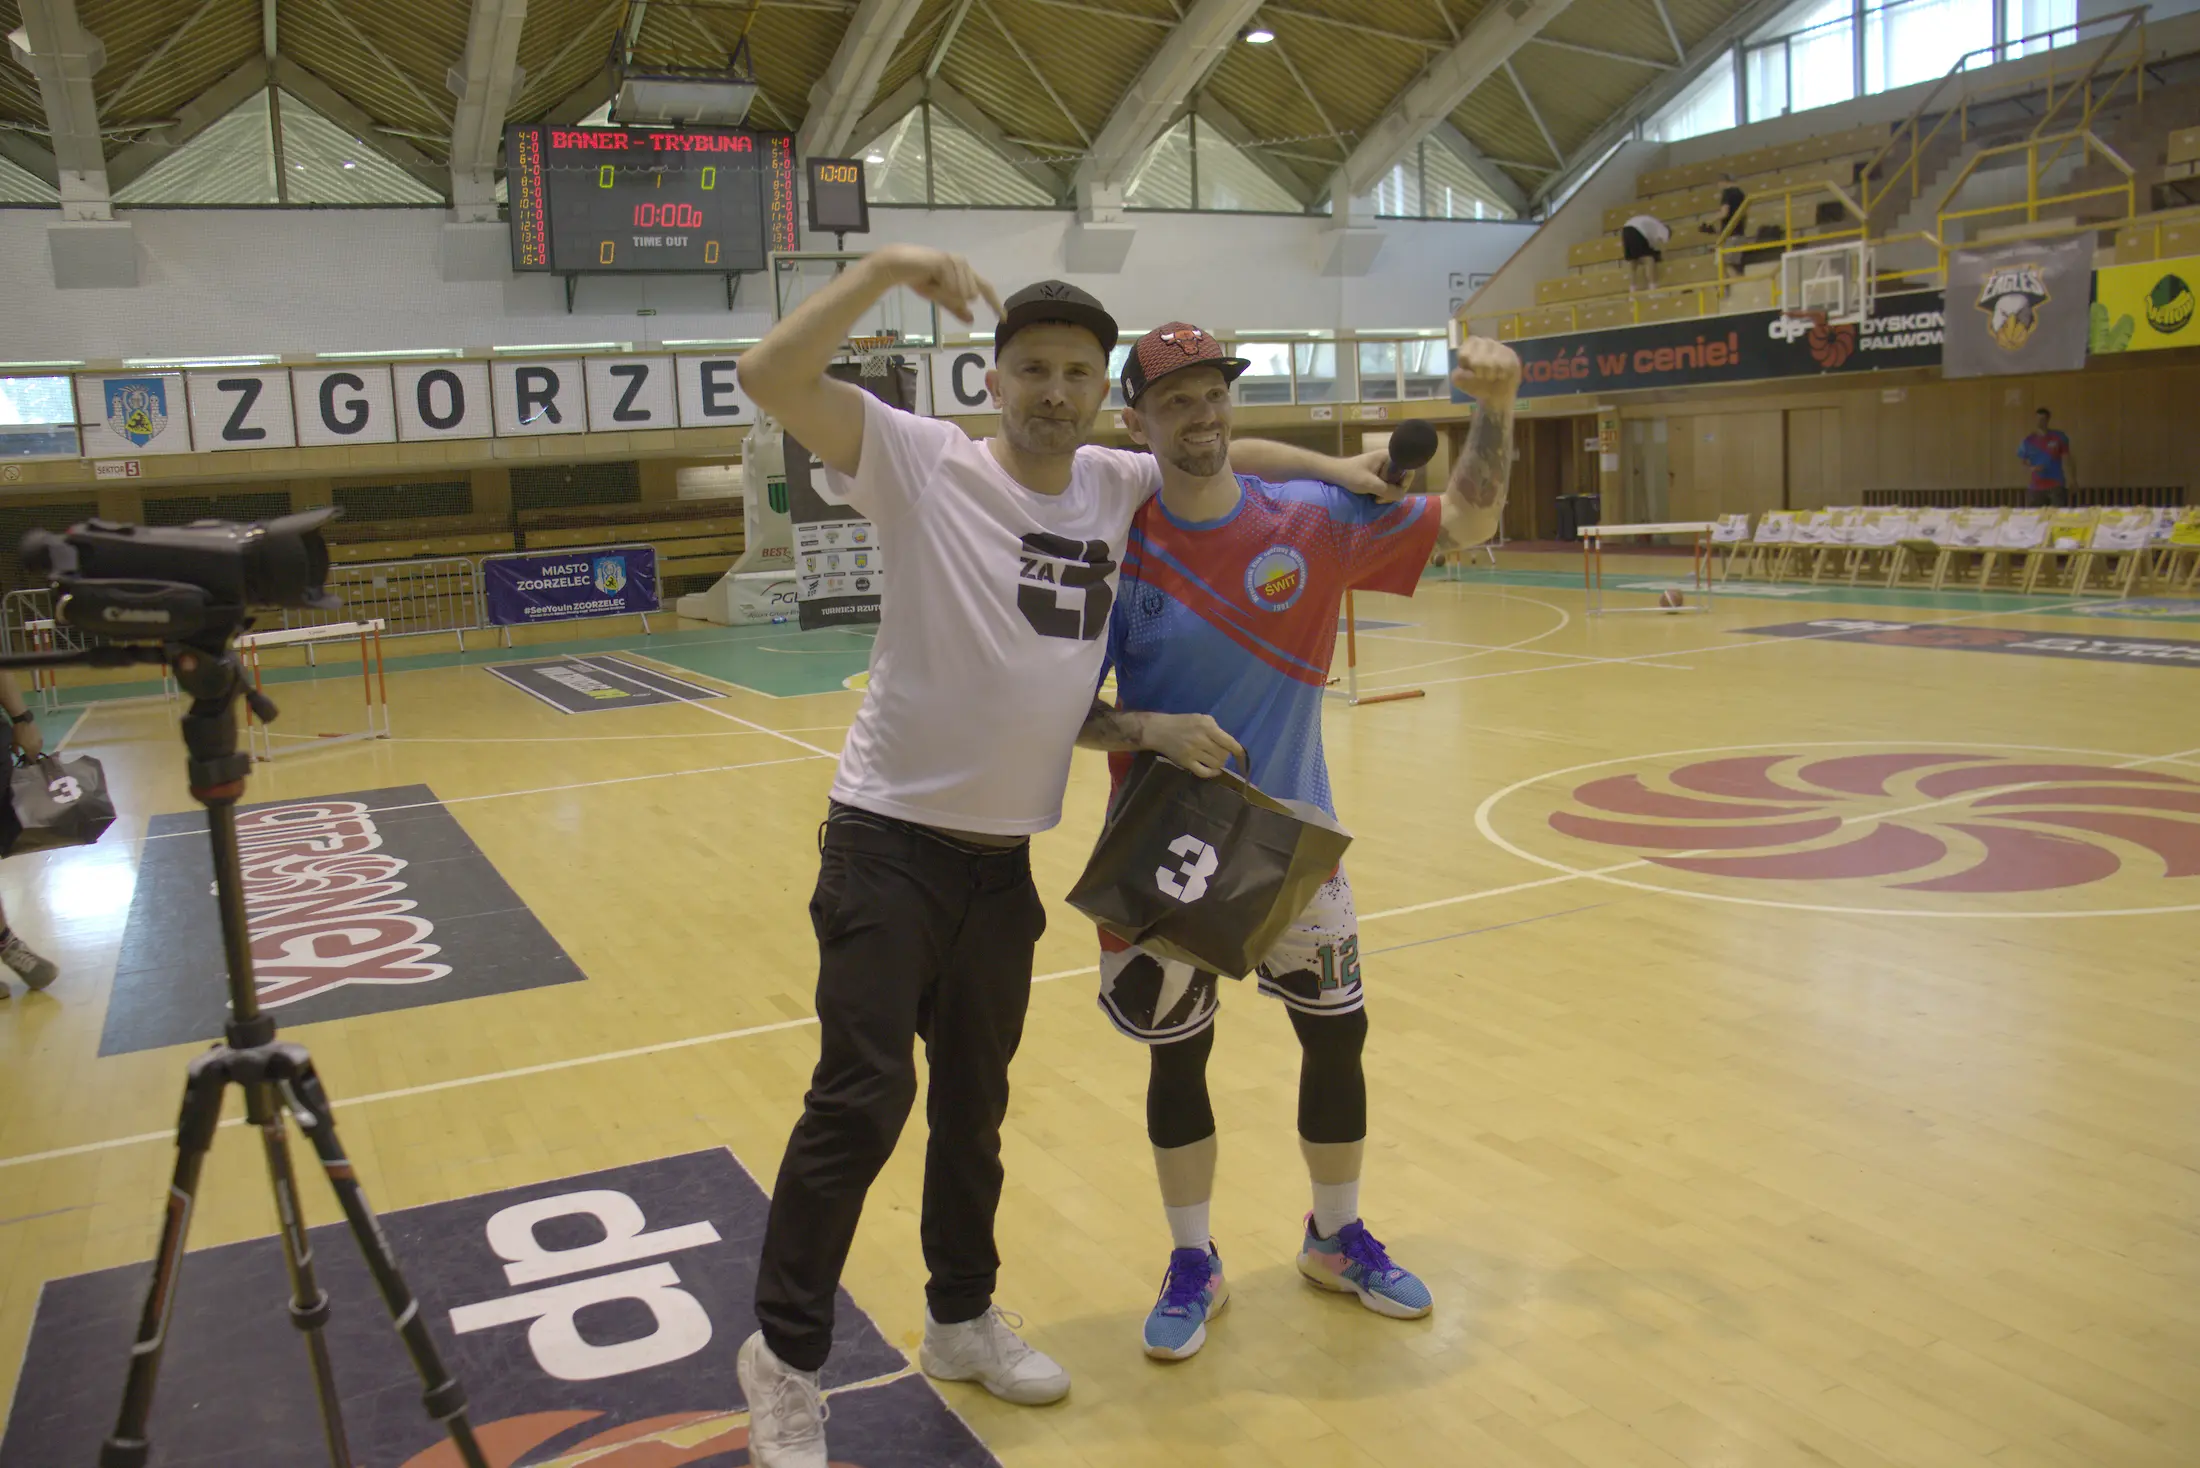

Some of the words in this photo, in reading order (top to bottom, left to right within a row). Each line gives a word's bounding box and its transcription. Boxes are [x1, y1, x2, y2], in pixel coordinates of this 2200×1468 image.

[552, 131, 629, 150] BANER
[649, 133, 752, 152] TRYBUNA
[600, 165, 615, 188] 0
[701, 166, 716, 190] 0
[820, 165, 858, 183] 10:00
[600, 241, 615, 264] 0
[704, 240, 719, 264] 0
[632, 236, 662, 247] TIME
[665, 236, 689, 247] OUT
[1981, 270, 2044, 303] EAGLES
[1860, 311, 1945, 335] DYSKON
[1859, 330, 1945, 351] PALIWOW
[1597, 352, 1627, 377] w
[1633, 331, 1739, 374] cenie!
[97, 465, 124, 475] SEKTOR
[127, 461, 138, 476] 5
[542, 563, 589, 577] MIASTO
[1020, 556, 1055, 584] ZA
[516, 575, 590, 591] ZGORZELEC
[1264, 574, 1296, 596] ŚWIT
[524, 604, 573, 615] #SeeYouIn
[573, 598, 625, 611] ZGORZELEC
[821, 606, 855, 616] TURNIEJ
[857, 604, 881, 613] RZUT
[48, 775, 83, 804] 3
[1155, 833, 1219, 904] 3
[1316, 932, 1361, 990] 12
[449, 1189, 722, 1380] dp
